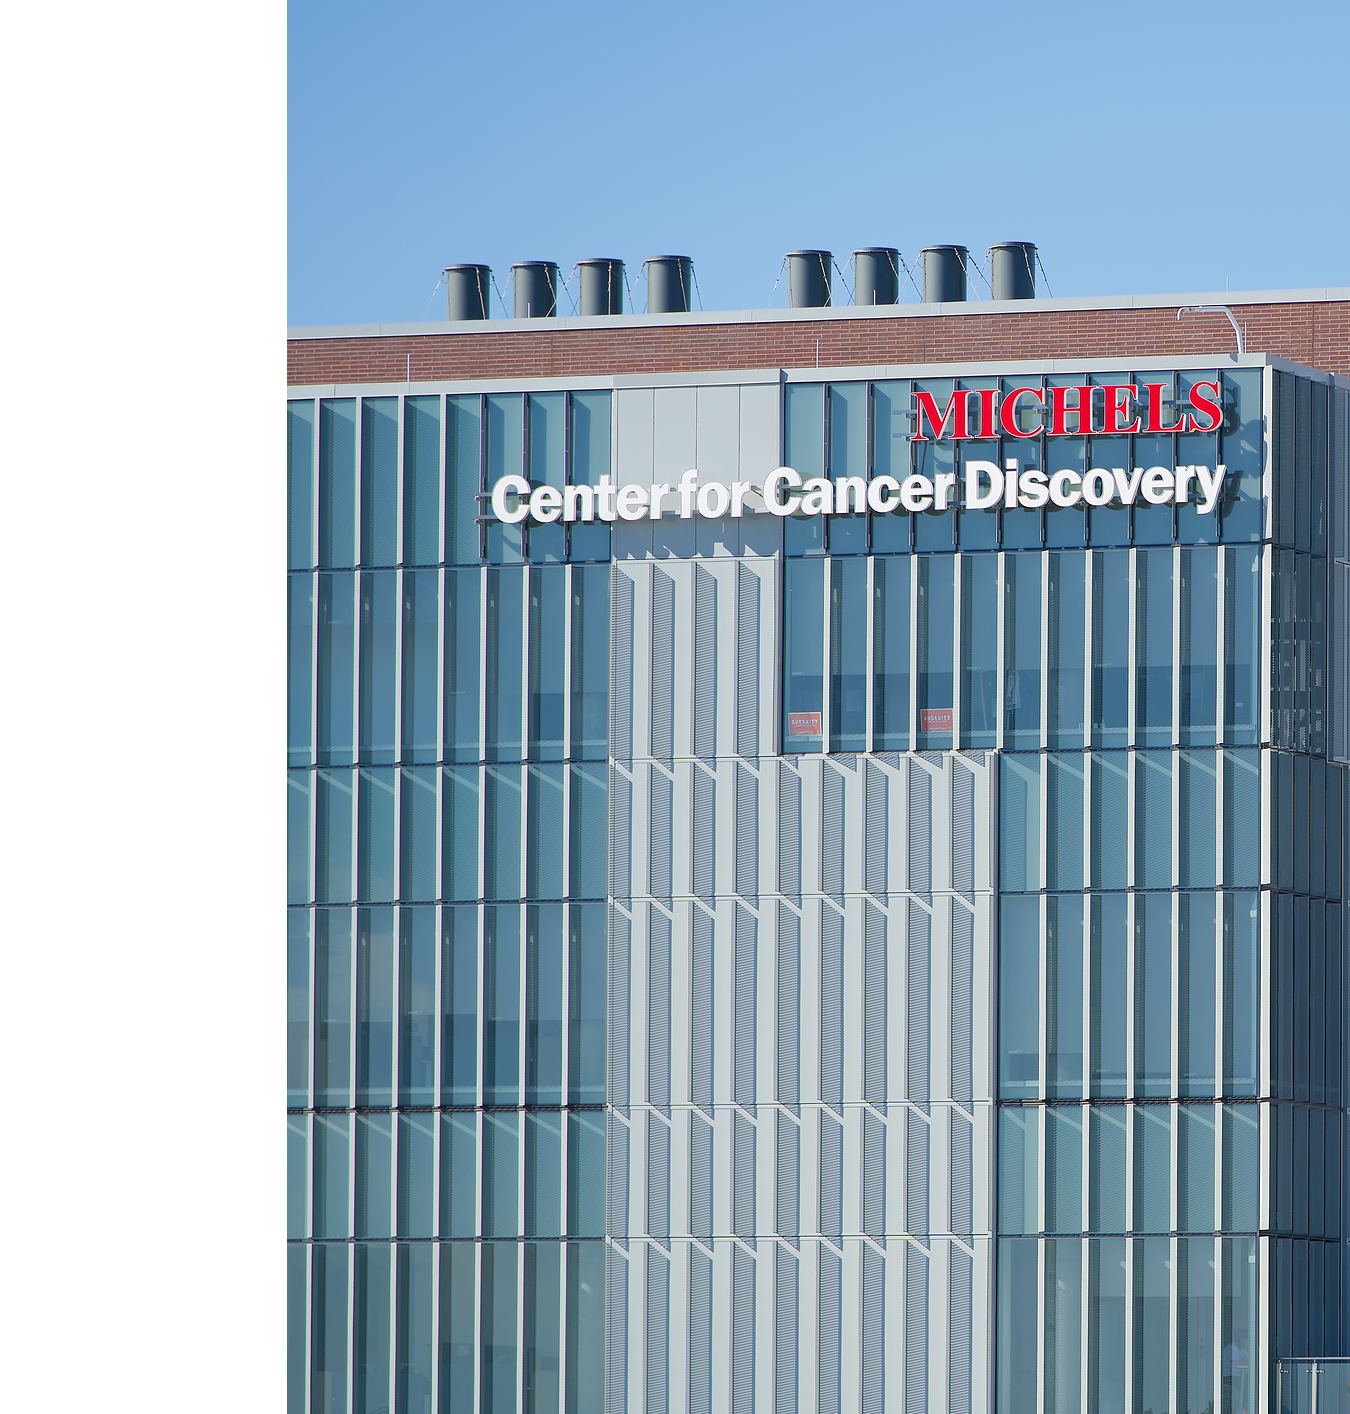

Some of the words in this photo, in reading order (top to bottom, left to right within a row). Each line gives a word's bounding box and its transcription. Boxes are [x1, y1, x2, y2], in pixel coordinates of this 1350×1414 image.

[911, 381, 1223, 441] MICHELS
[492, 474, 669, 523] Center
[677, 469, 749, 519] for
[763, 467, 956, 517] Cancer
[966, 458, 1227, 514] Discovery
